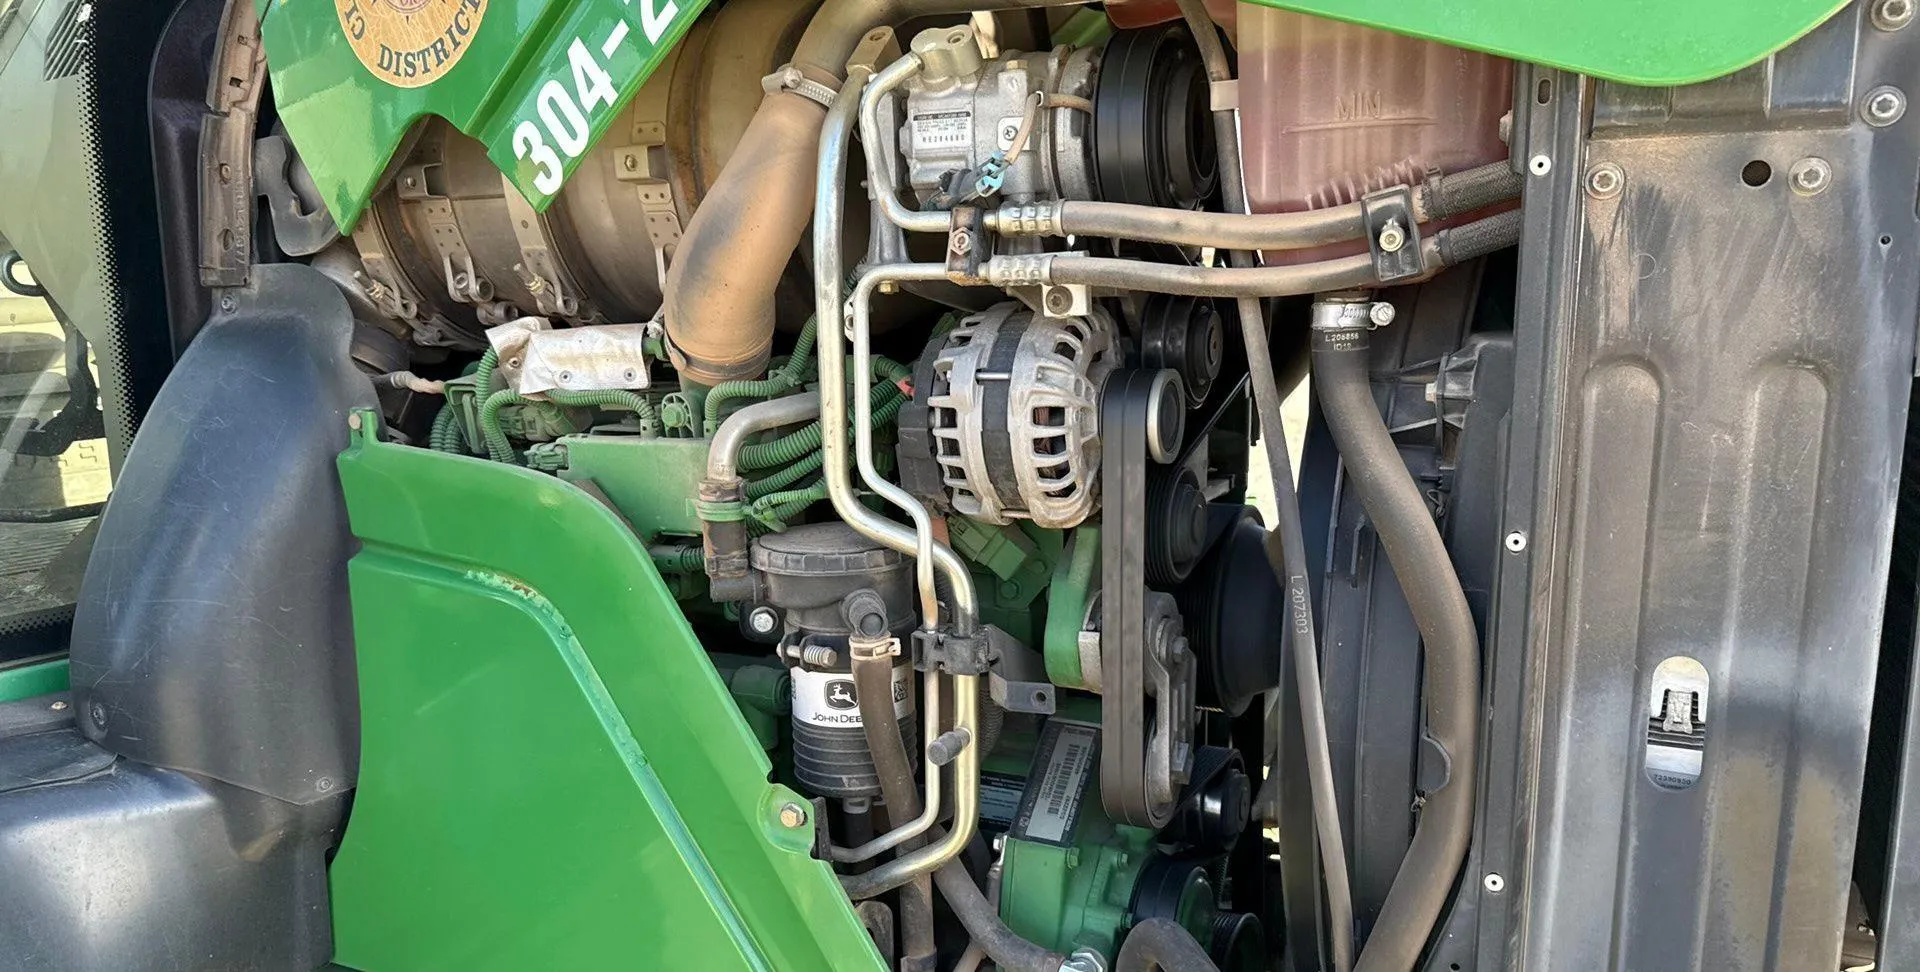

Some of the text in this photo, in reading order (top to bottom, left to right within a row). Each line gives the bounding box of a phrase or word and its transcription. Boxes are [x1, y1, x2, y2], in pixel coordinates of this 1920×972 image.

[1336, 91, 1382, 121] MIN
[1292, 588, 1309, 634] 207303
[812, 713, 863, 724] JOHN DEE
